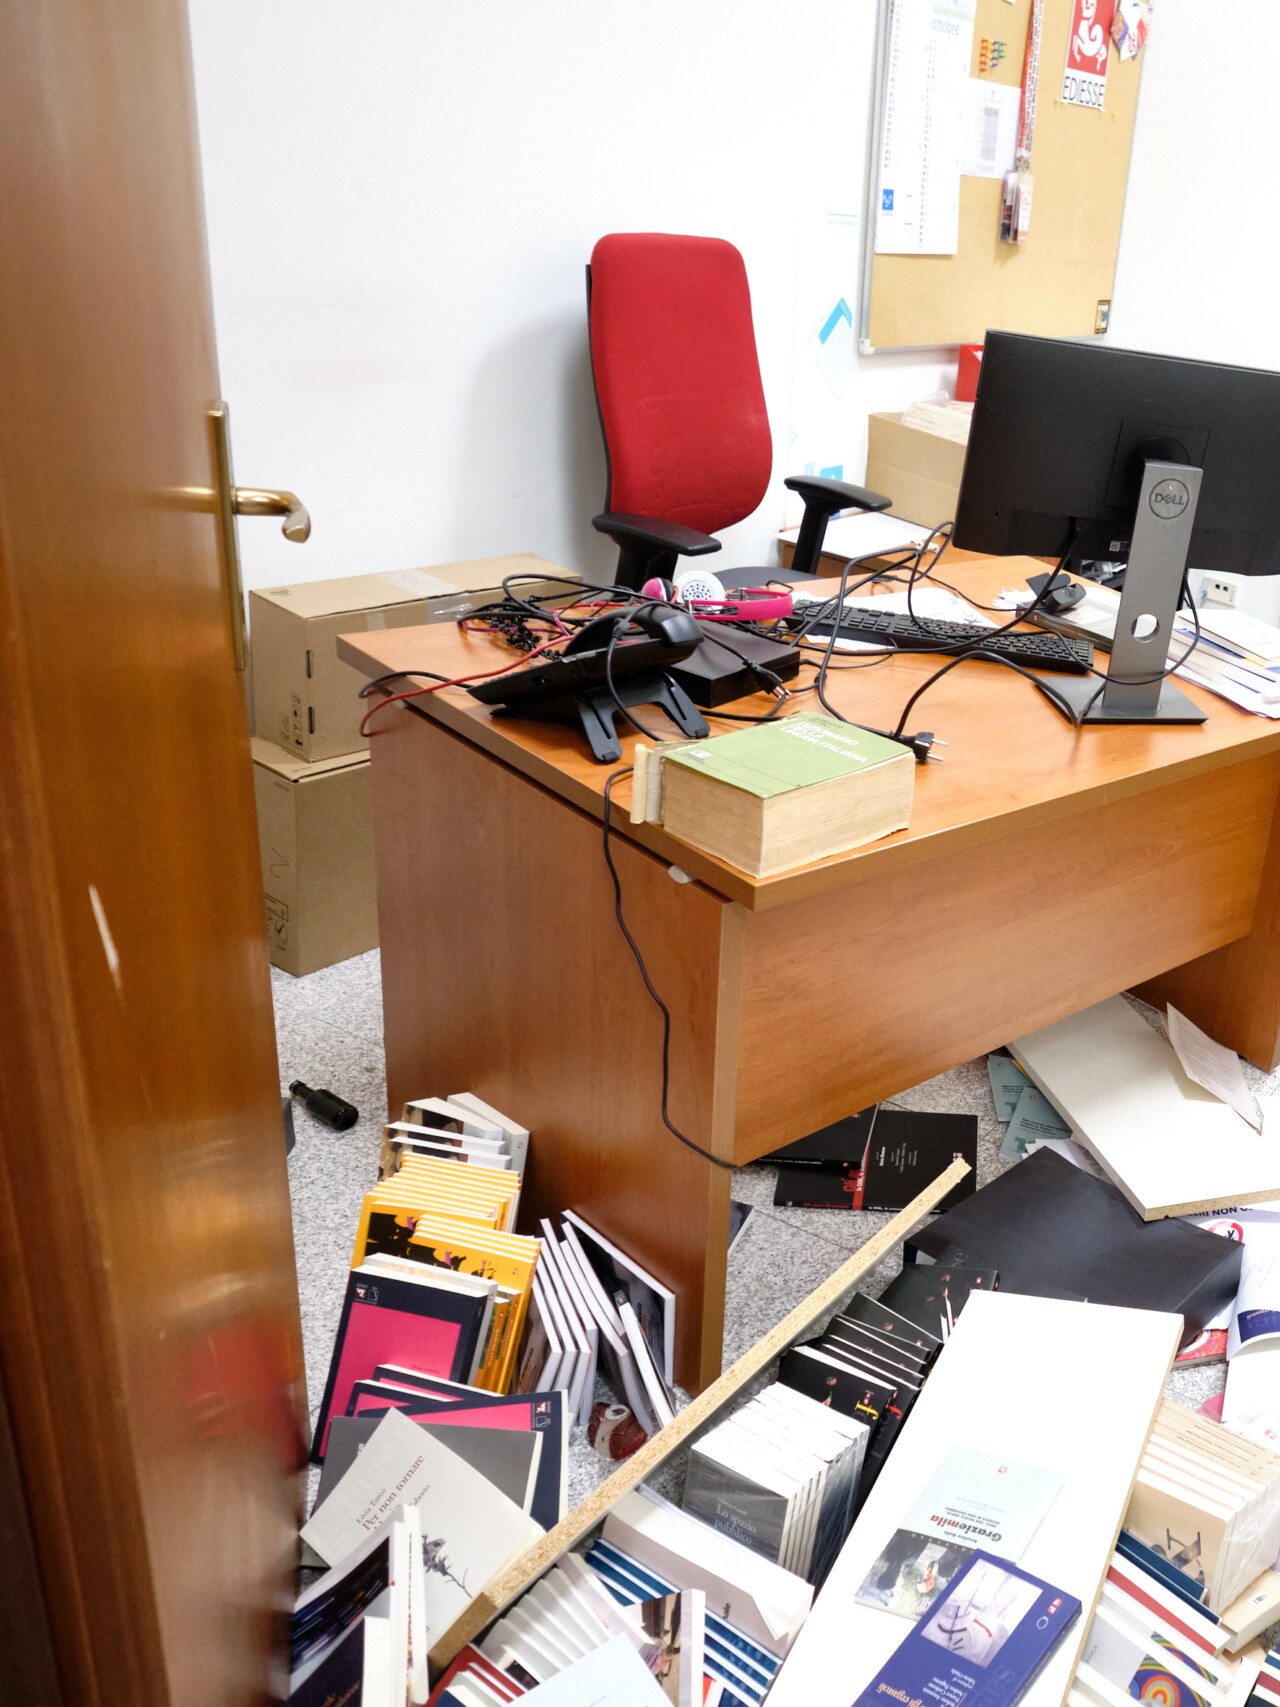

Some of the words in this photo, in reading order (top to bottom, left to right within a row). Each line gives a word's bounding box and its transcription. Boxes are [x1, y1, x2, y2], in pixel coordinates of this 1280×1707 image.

[1062, 76, 1105, 107] EDIESSE
[1154, 492, 1185, 506] DELL
[362, 1513, 380, 1531] Per
[379, 1492, 398, 1513] non
[395, 1455, 424, 1491] tornare
[714, 1519, 752, 1544] pubblico
[716, 1503, 729, 1519] Lo
[731, 1515, 757, 1534] spazio
[929, 1514, 1003, 1542] Graziemila
[876, 1682, 910, 1703] ergastoli
